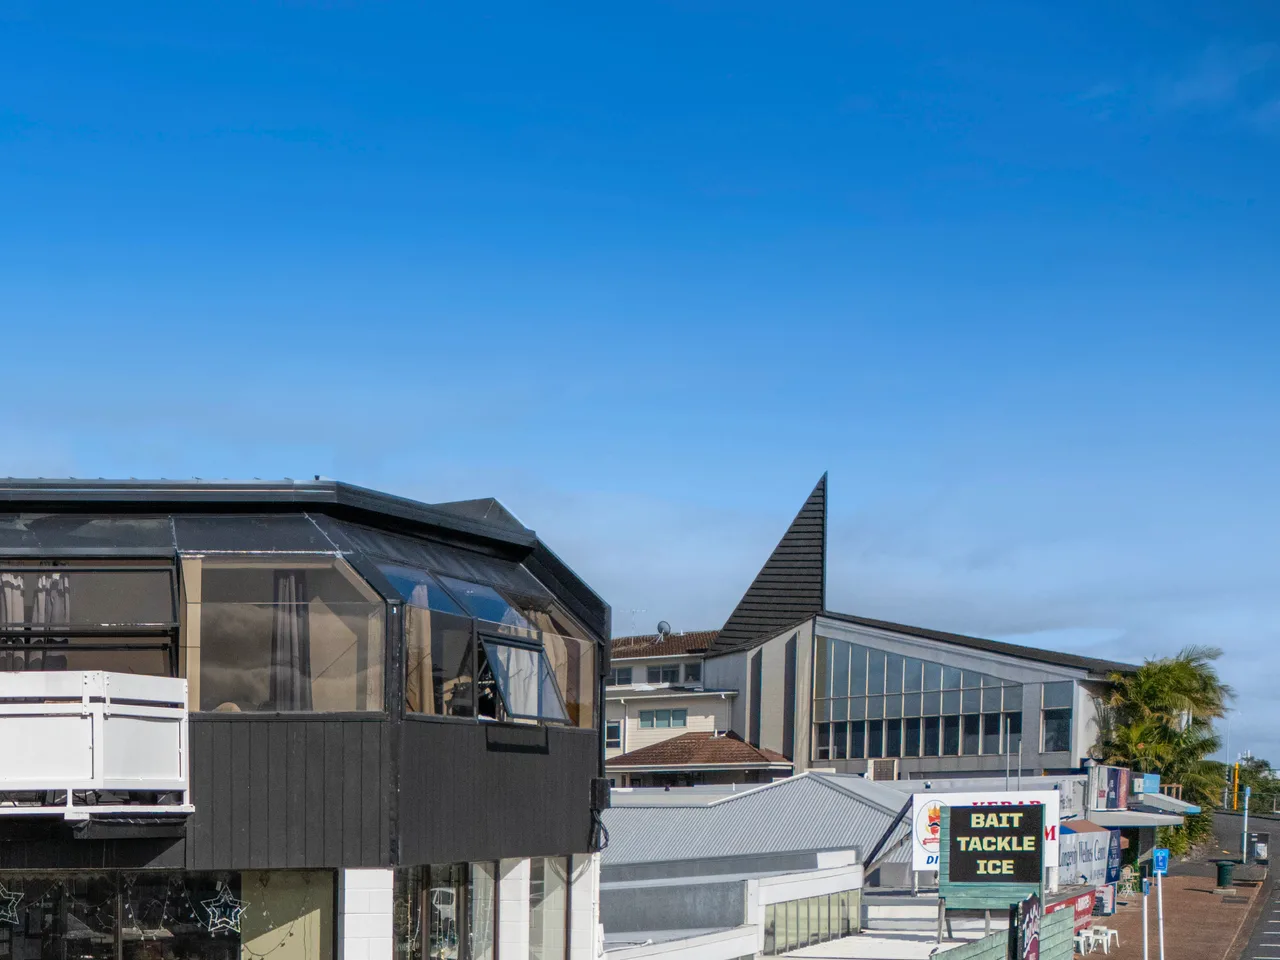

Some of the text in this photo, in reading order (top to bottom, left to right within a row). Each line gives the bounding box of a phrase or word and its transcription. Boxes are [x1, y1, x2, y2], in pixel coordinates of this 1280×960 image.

[971, 812, 1023, 828] BAIT
[956, 836, 1036, 851] TACKLE
[976, 859, 1015, 874] ICE
